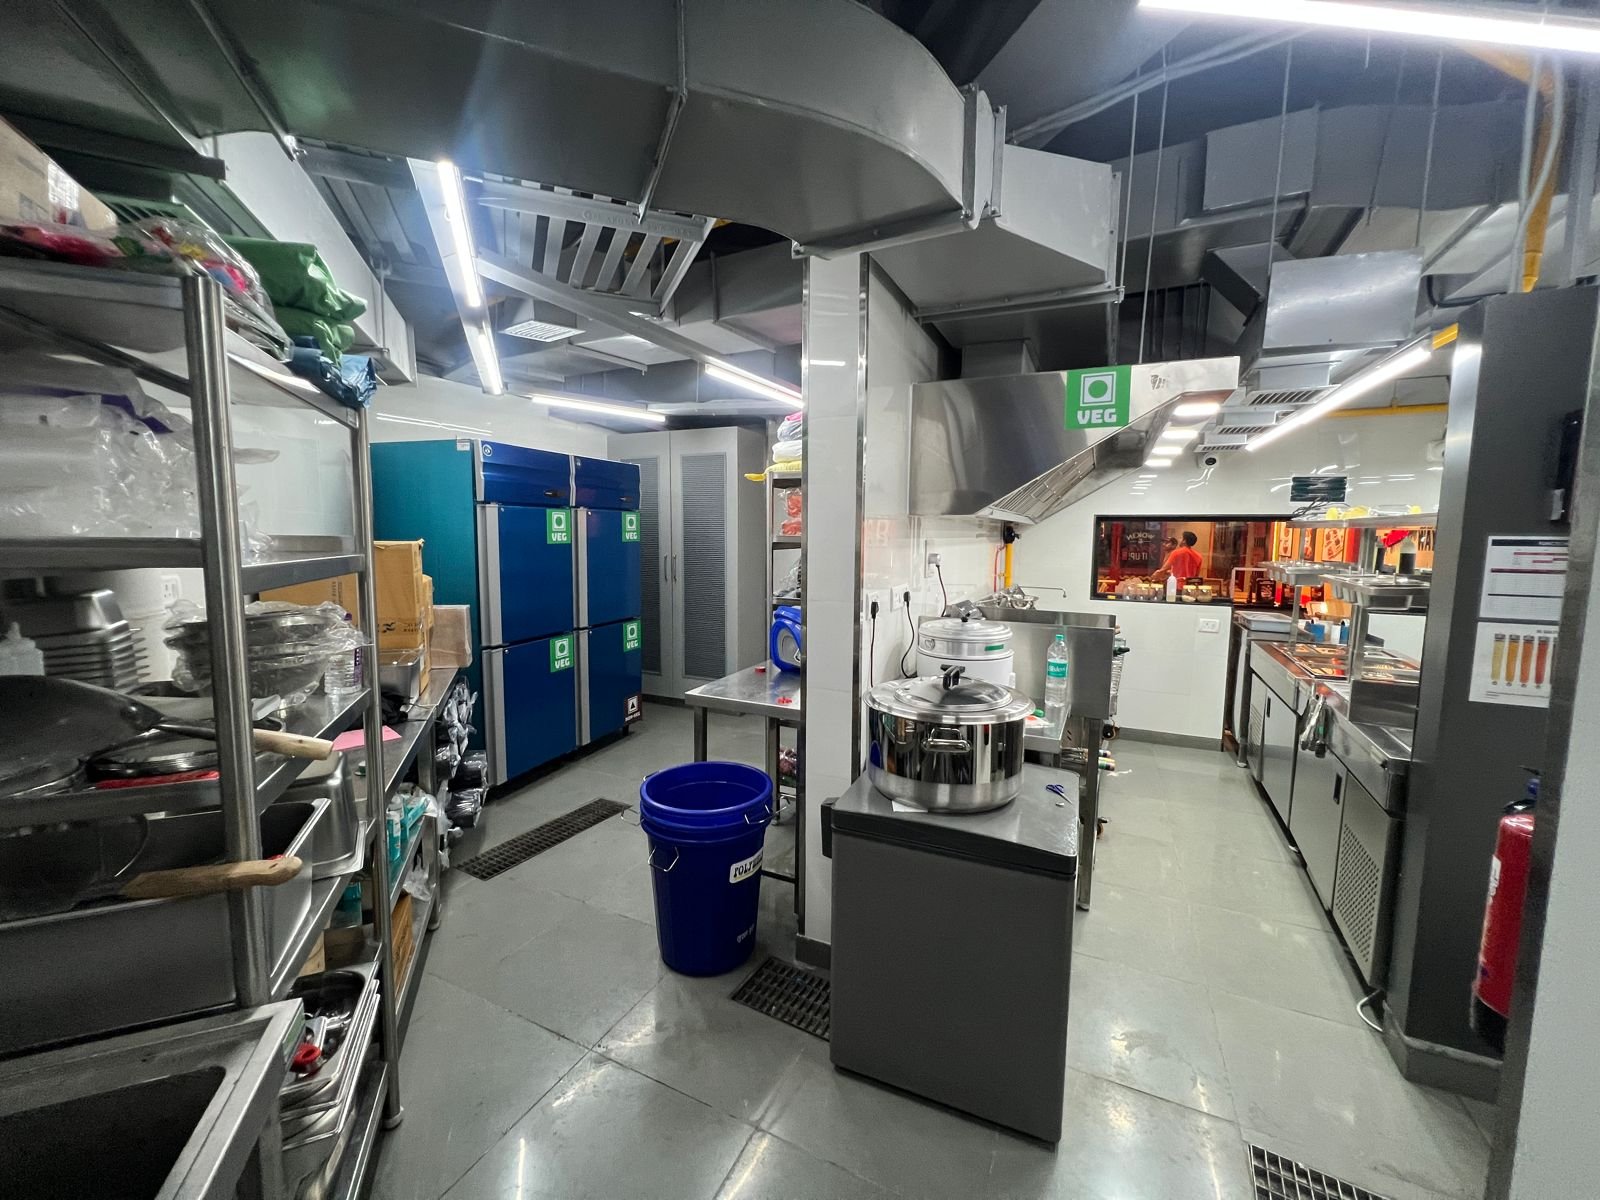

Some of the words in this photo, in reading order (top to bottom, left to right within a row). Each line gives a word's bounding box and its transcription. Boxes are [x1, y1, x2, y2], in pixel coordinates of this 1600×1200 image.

[1077, 409, 1117, 424] VEG
[551, 532, 567, 542] VEG
[625, 531, 638, 540] VEG
[626, 639, 639, 649] VEG
[555, 658, 570, 669] VEG
